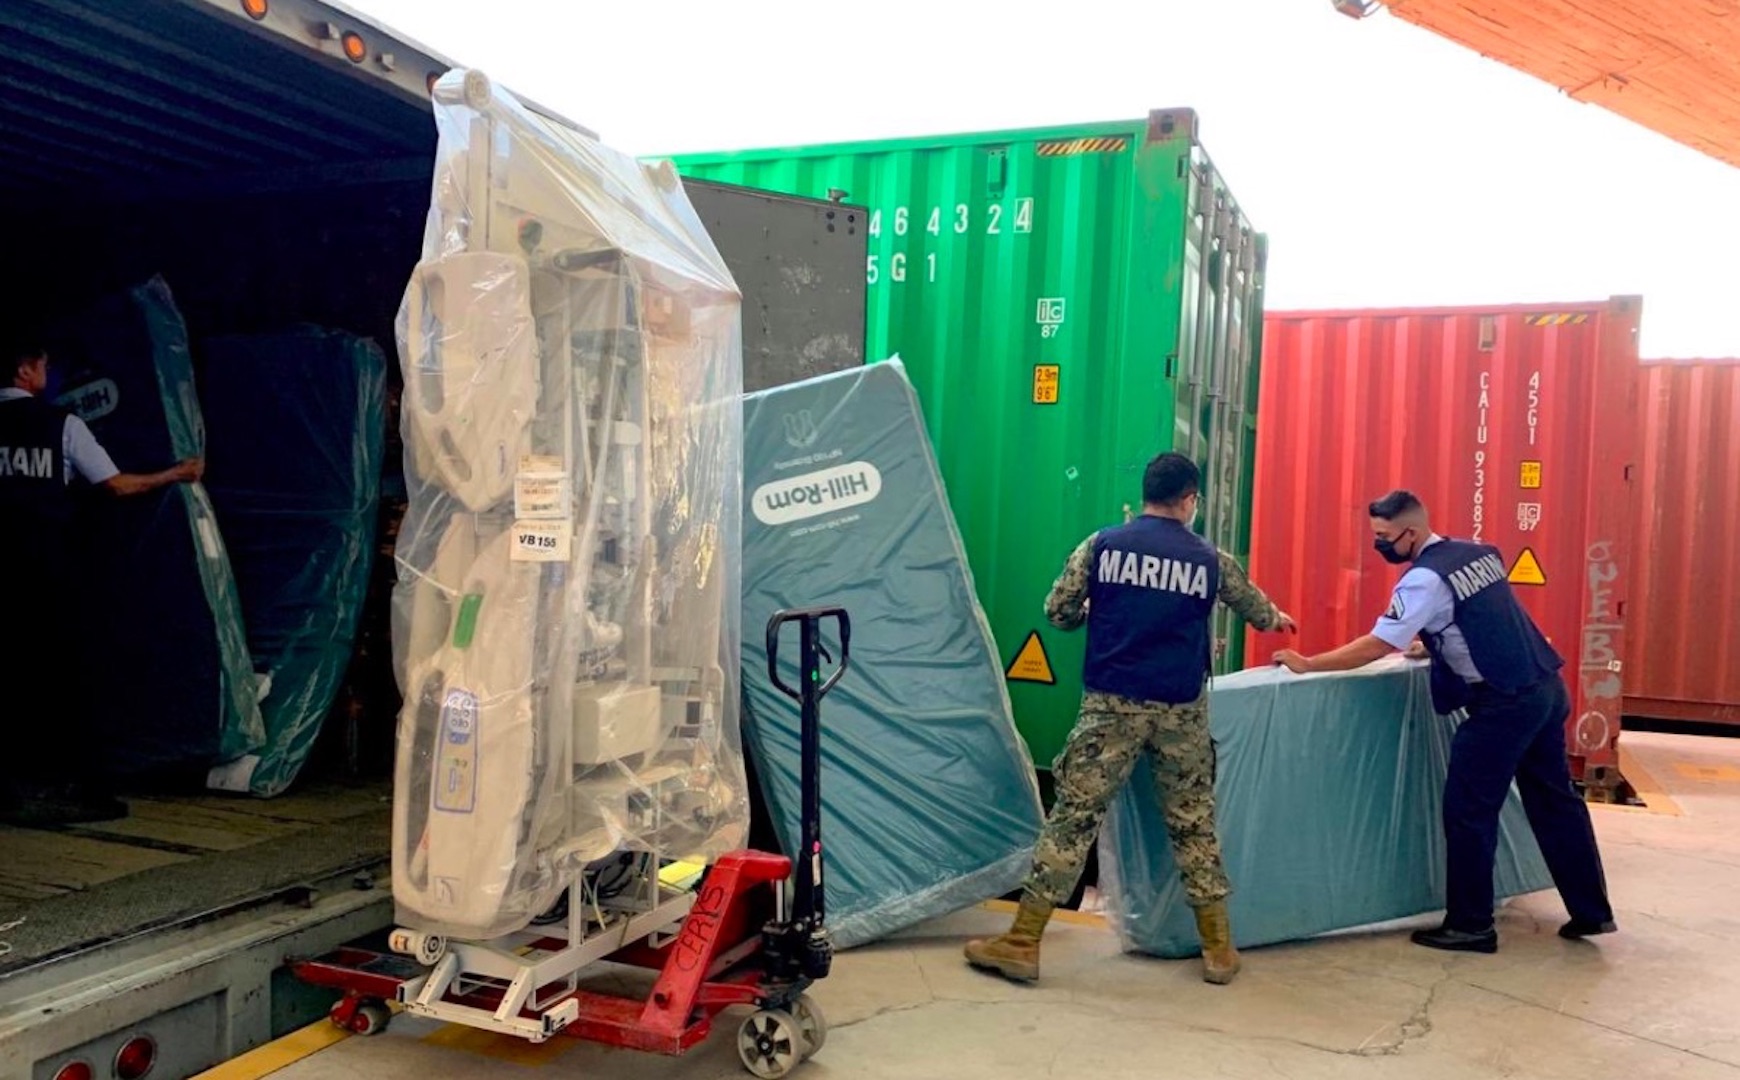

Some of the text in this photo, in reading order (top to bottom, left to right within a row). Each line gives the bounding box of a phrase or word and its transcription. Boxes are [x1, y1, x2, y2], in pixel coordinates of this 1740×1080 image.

[1041, 324, 1059, 338] 87
[1472, 372, 1489, 545] CAIU 93682
[765, 471, 869, 510] Hill-Rom
[1098, 549, 1208, 599] MARINA
[1448, 553, 1506, 600] MARIN
